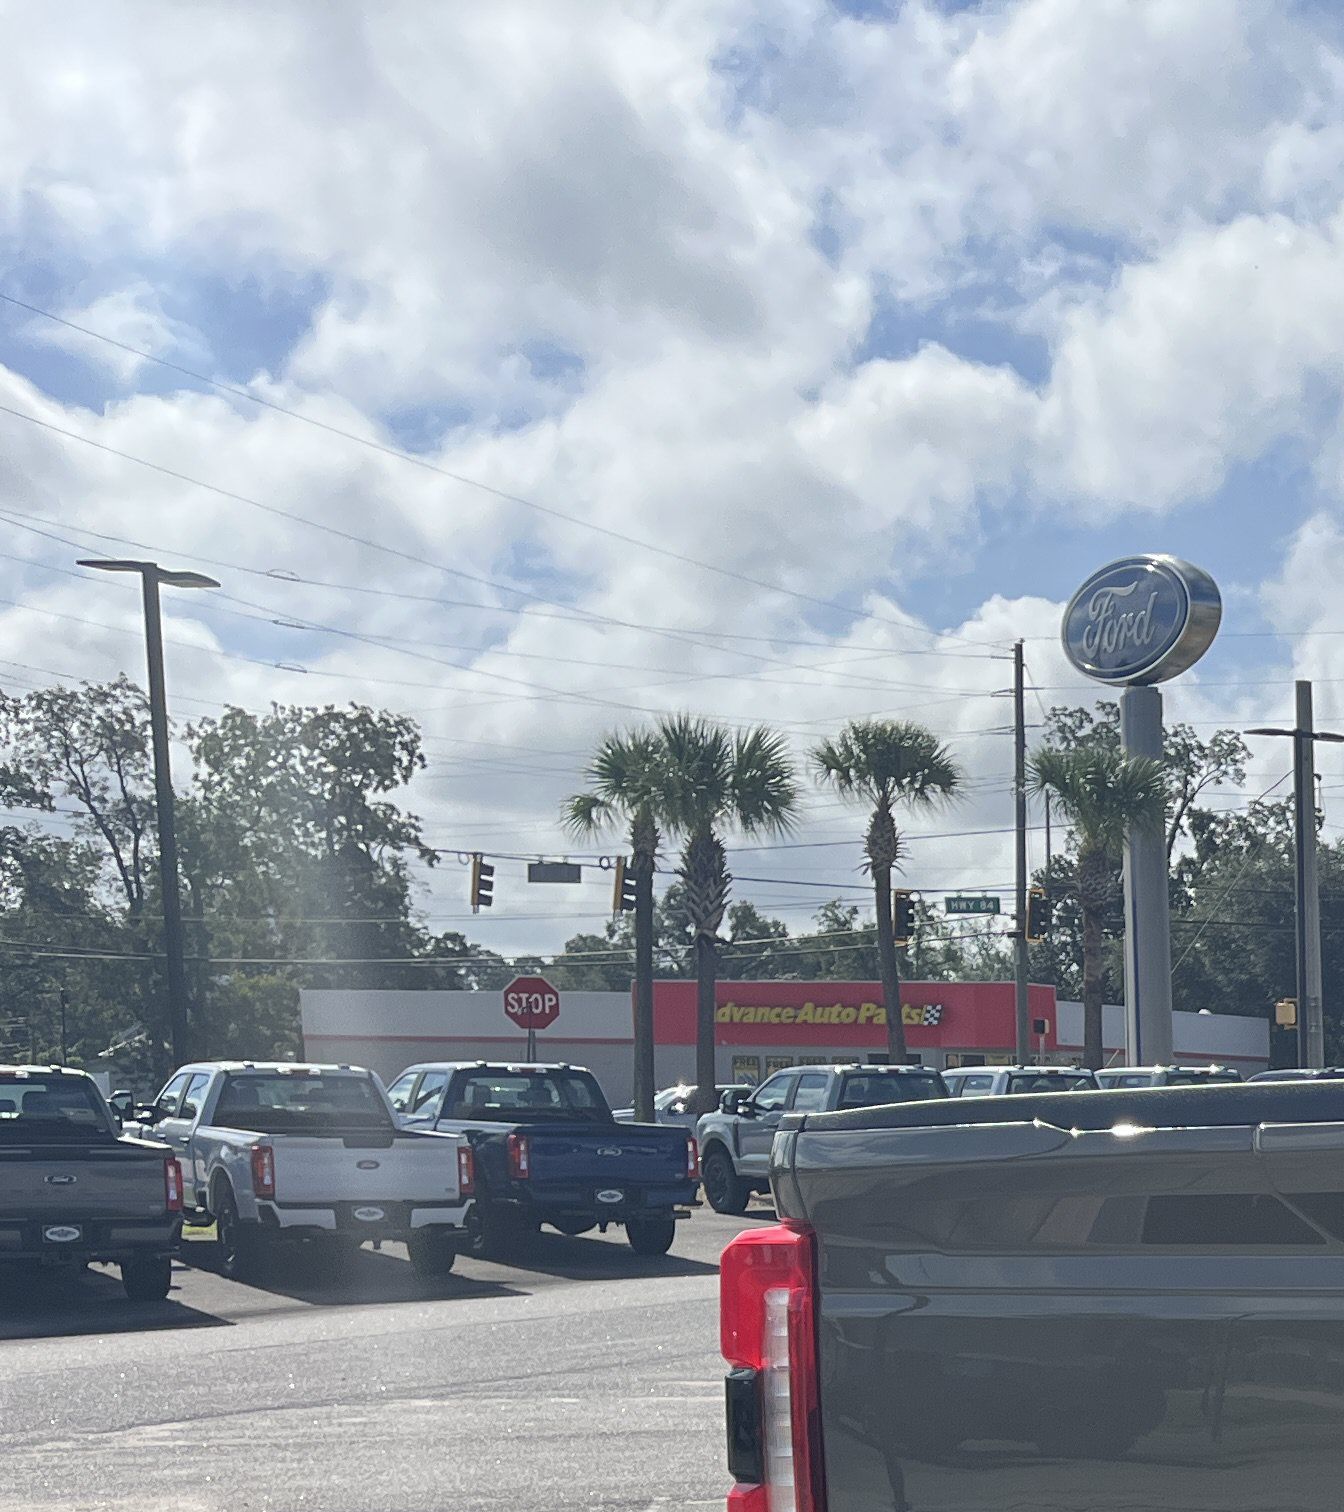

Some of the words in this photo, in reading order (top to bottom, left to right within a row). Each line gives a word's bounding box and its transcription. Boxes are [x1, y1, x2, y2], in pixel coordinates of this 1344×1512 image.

[1083, 581, 1158, 659] Ford
[507, 993, 556, 1014] STOP
[715, 1003, 798, 1024] dvance
[796, 1003, 857, 1025] Auto
[857, 1003, 923, 1025] Pats
